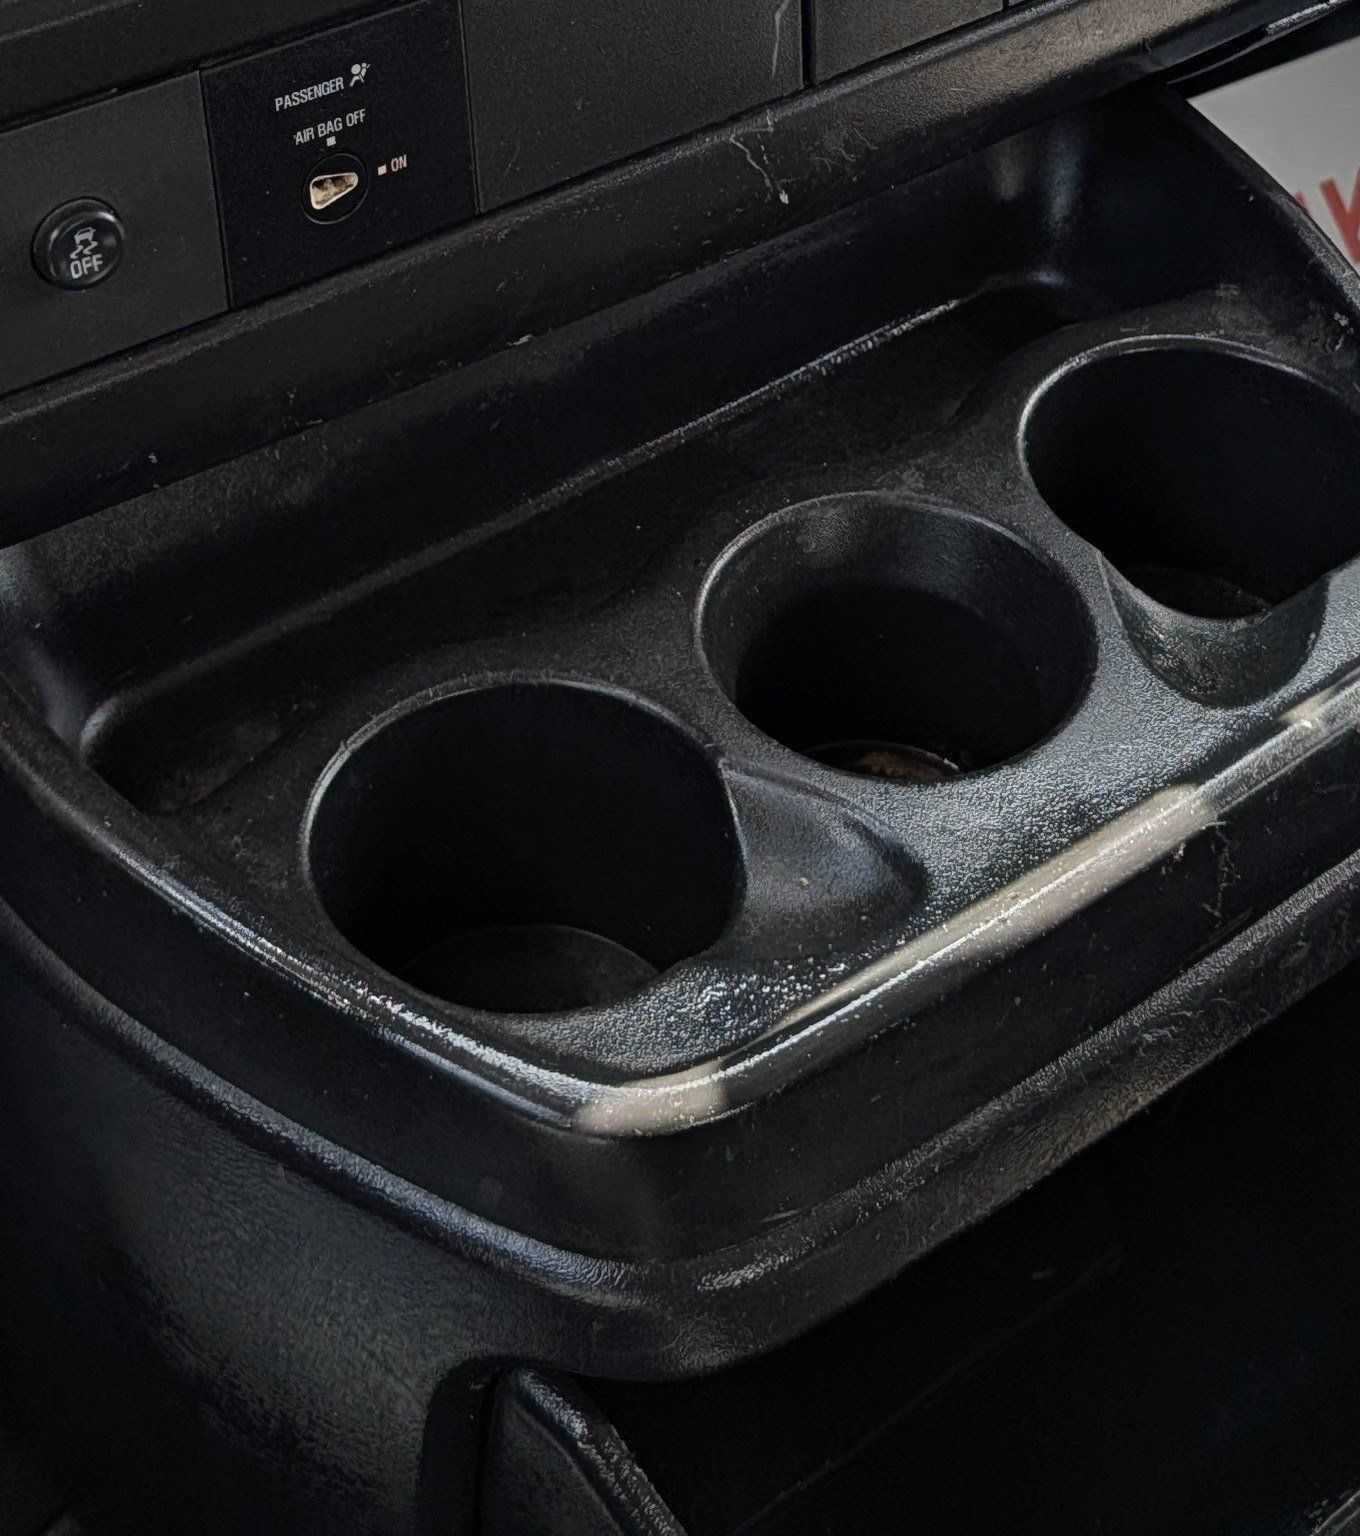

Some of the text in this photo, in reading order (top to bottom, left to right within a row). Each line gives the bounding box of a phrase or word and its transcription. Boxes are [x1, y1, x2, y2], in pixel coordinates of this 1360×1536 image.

[274, 76, 345, 112] PASSENGER
[294, 108, 366, 146] AIR BAG OFF
[390, 154, 408, 172] ON
[70, 253, 104, 280] OFF
